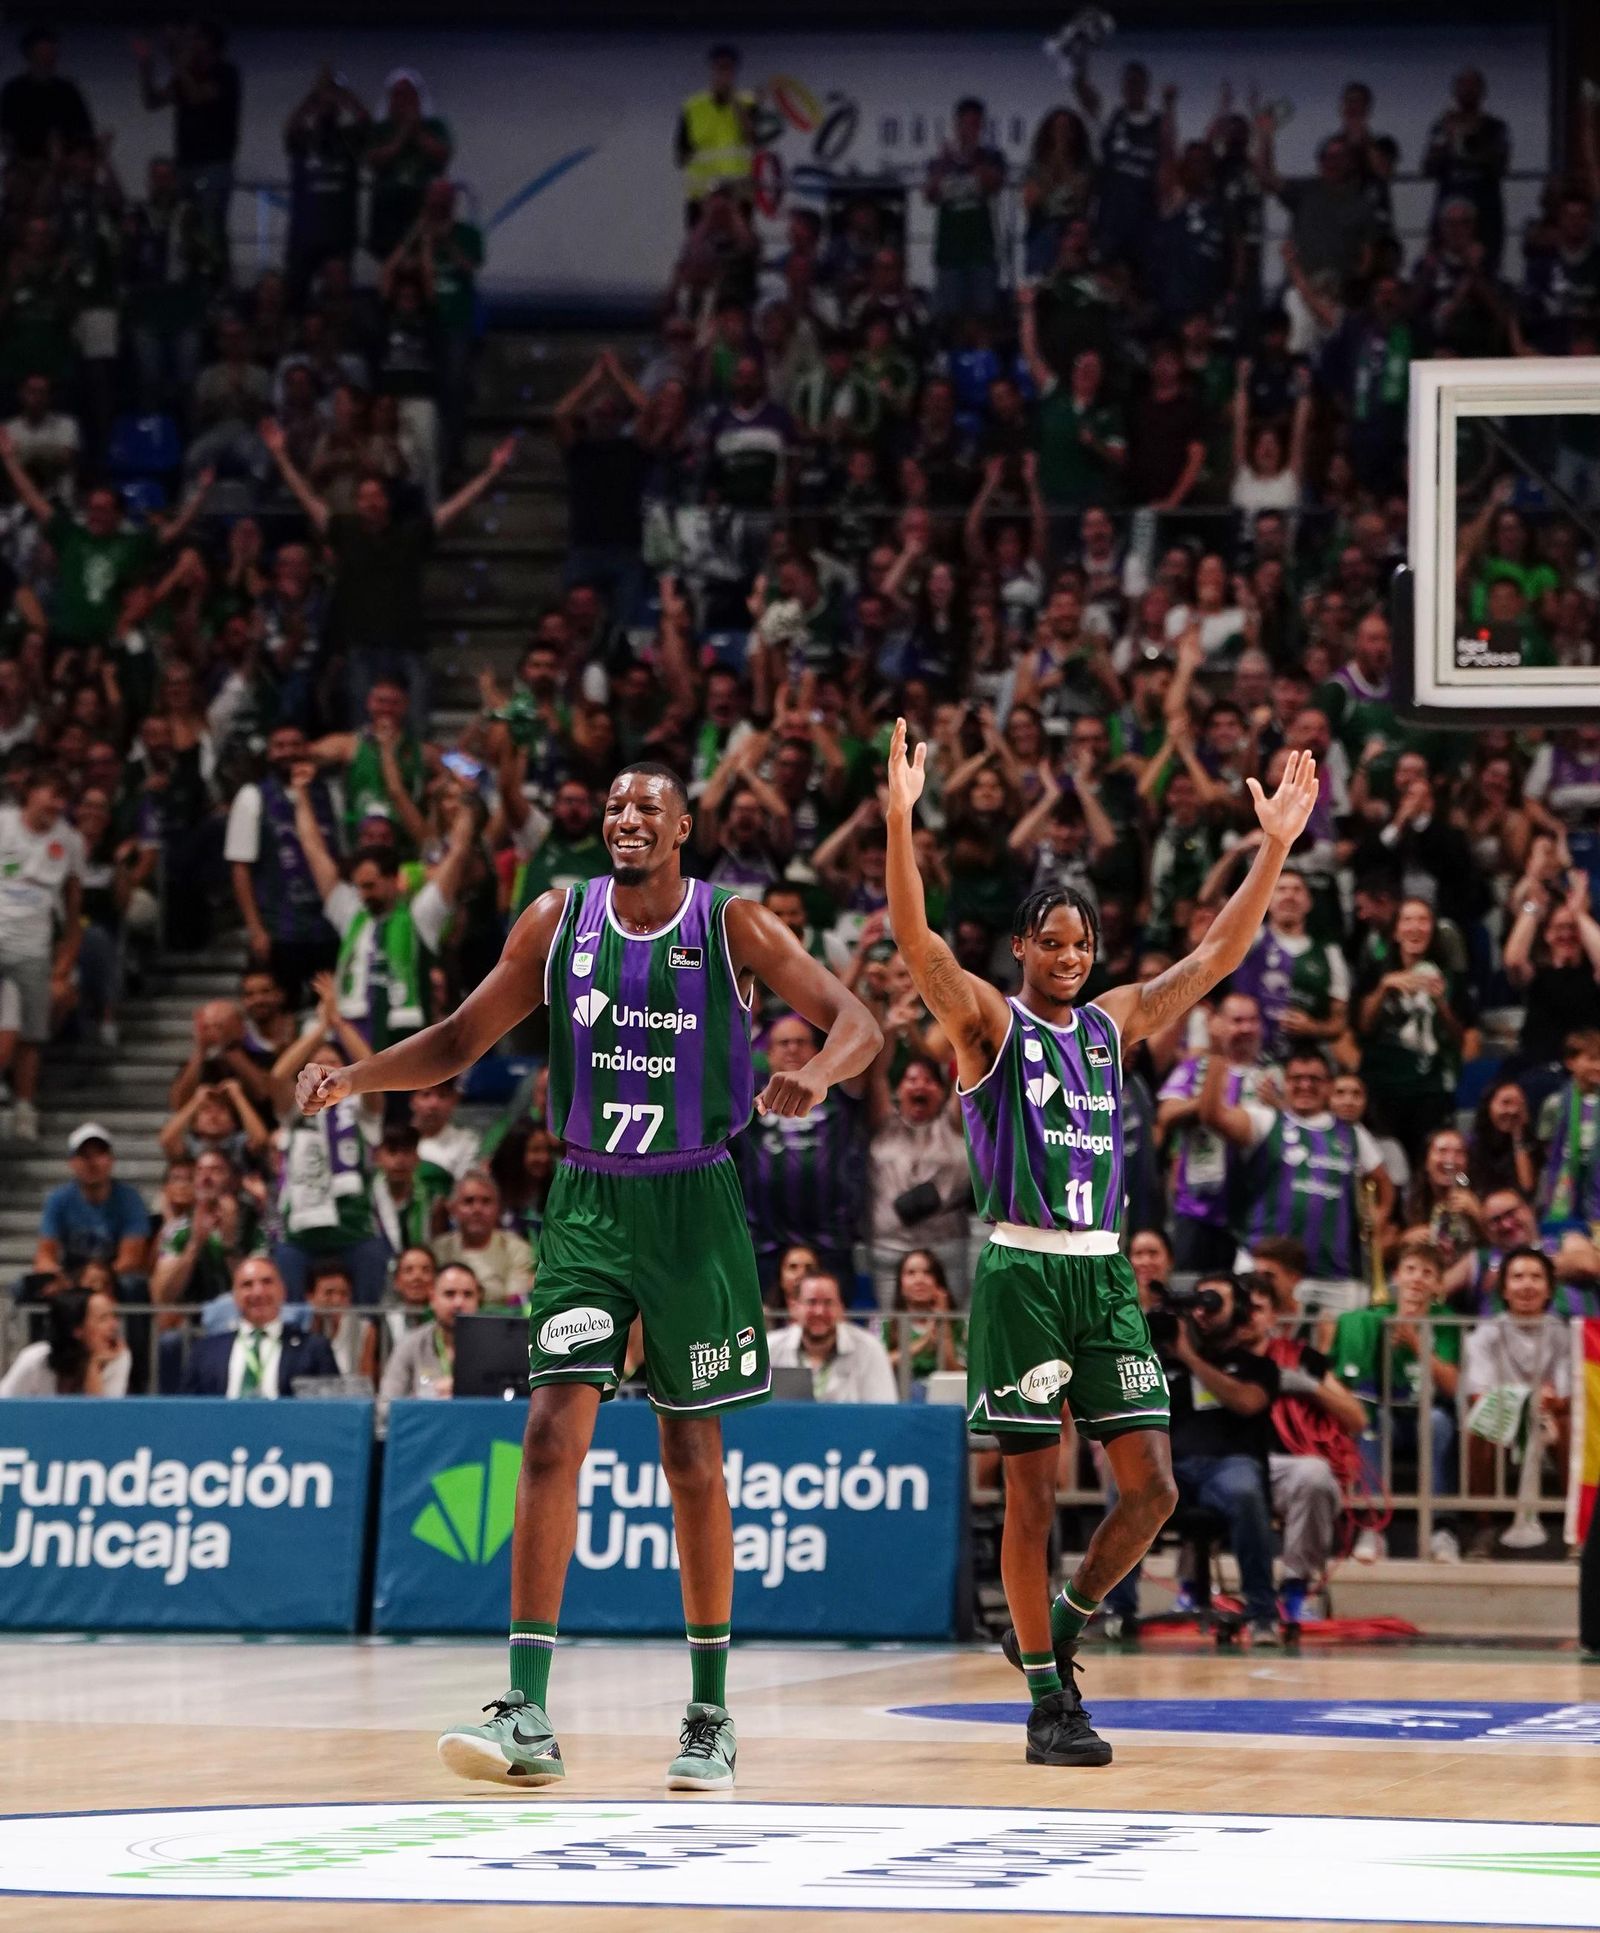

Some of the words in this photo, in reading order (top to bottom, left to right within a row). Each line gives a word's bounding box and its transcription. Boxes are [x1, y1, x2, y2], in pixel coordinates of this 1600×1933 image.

[612, 1004, 698, 1035] Unicaja
[602, 1101, 665, 1155] 77
[1065, 1178, 1094, 1226] 11
[544, 1311, 611, 1347] famadesa
[689, 1341, 711, 1351] sabor
[0, 1446, 333, 1508] Fundación
